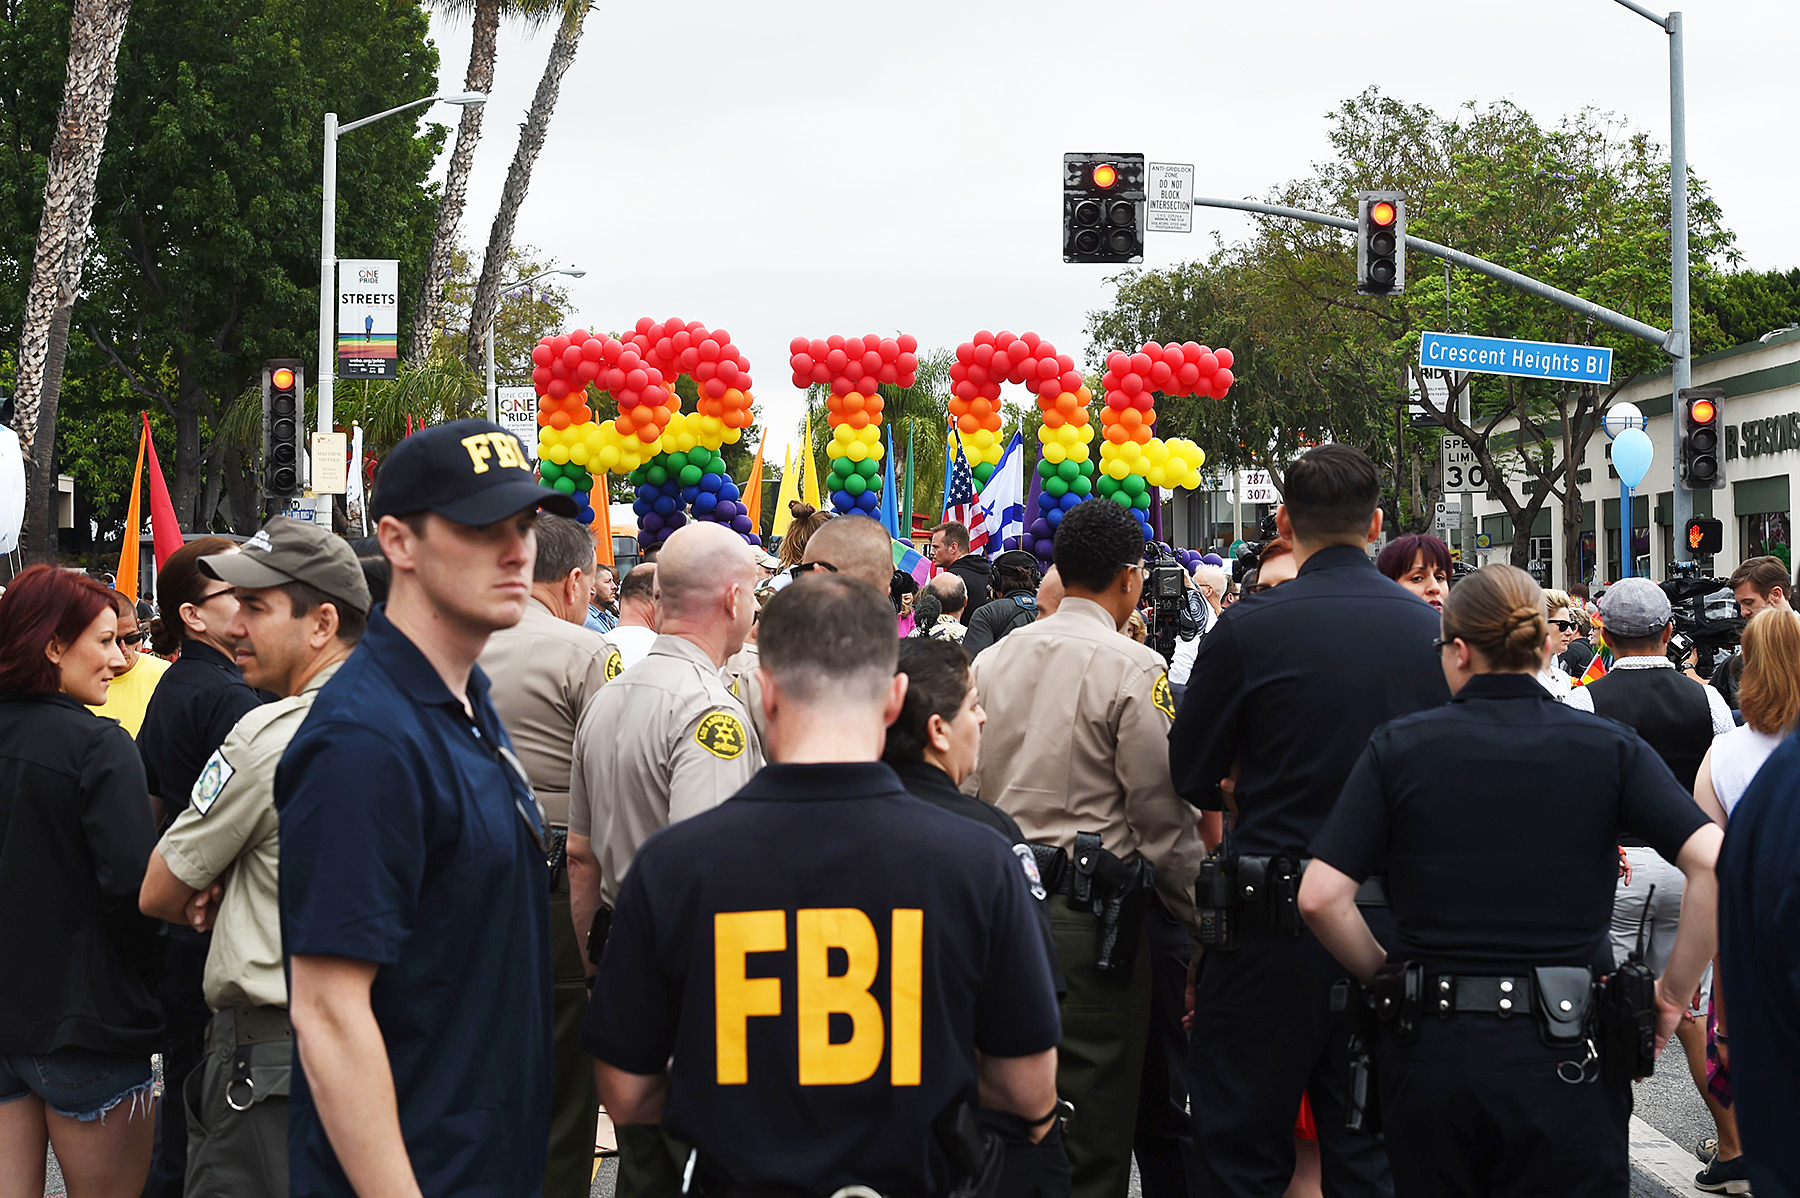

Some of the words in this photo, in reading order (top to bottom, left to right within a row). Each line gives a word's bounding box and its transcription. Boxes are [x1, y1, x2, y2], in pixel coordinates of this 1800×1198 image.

[1159, 179, 1168, 188] DO
[1171, 180, 1183, 189] NOT
[1160, 190, 1181, 199] BLOCK
[1150, 200, 1190, 210] INTERSECTION
[358, 269, 379, 278] ONE
[341, 293, 396, 305] STREETS
[1429, 341, 1506, 366] Crescent
[1512, 349, 1580, 375] Heights
[500, 399, 535, 412] ONE
[500, 411, 535, 422] RIDE
[1740, 411, 1800, 458] SEASONS
[460, 432, 532, 474] FBI
[1448, 452, 1475, 462] LIMI
[1247, 474, 1265, 485] 287
[1446, 465, 1486, 488] 30
[1247, 489, 1266, 500] 307
[699, 726, 709, 740] LOS
[714, 907, 924, 1087] FBI
